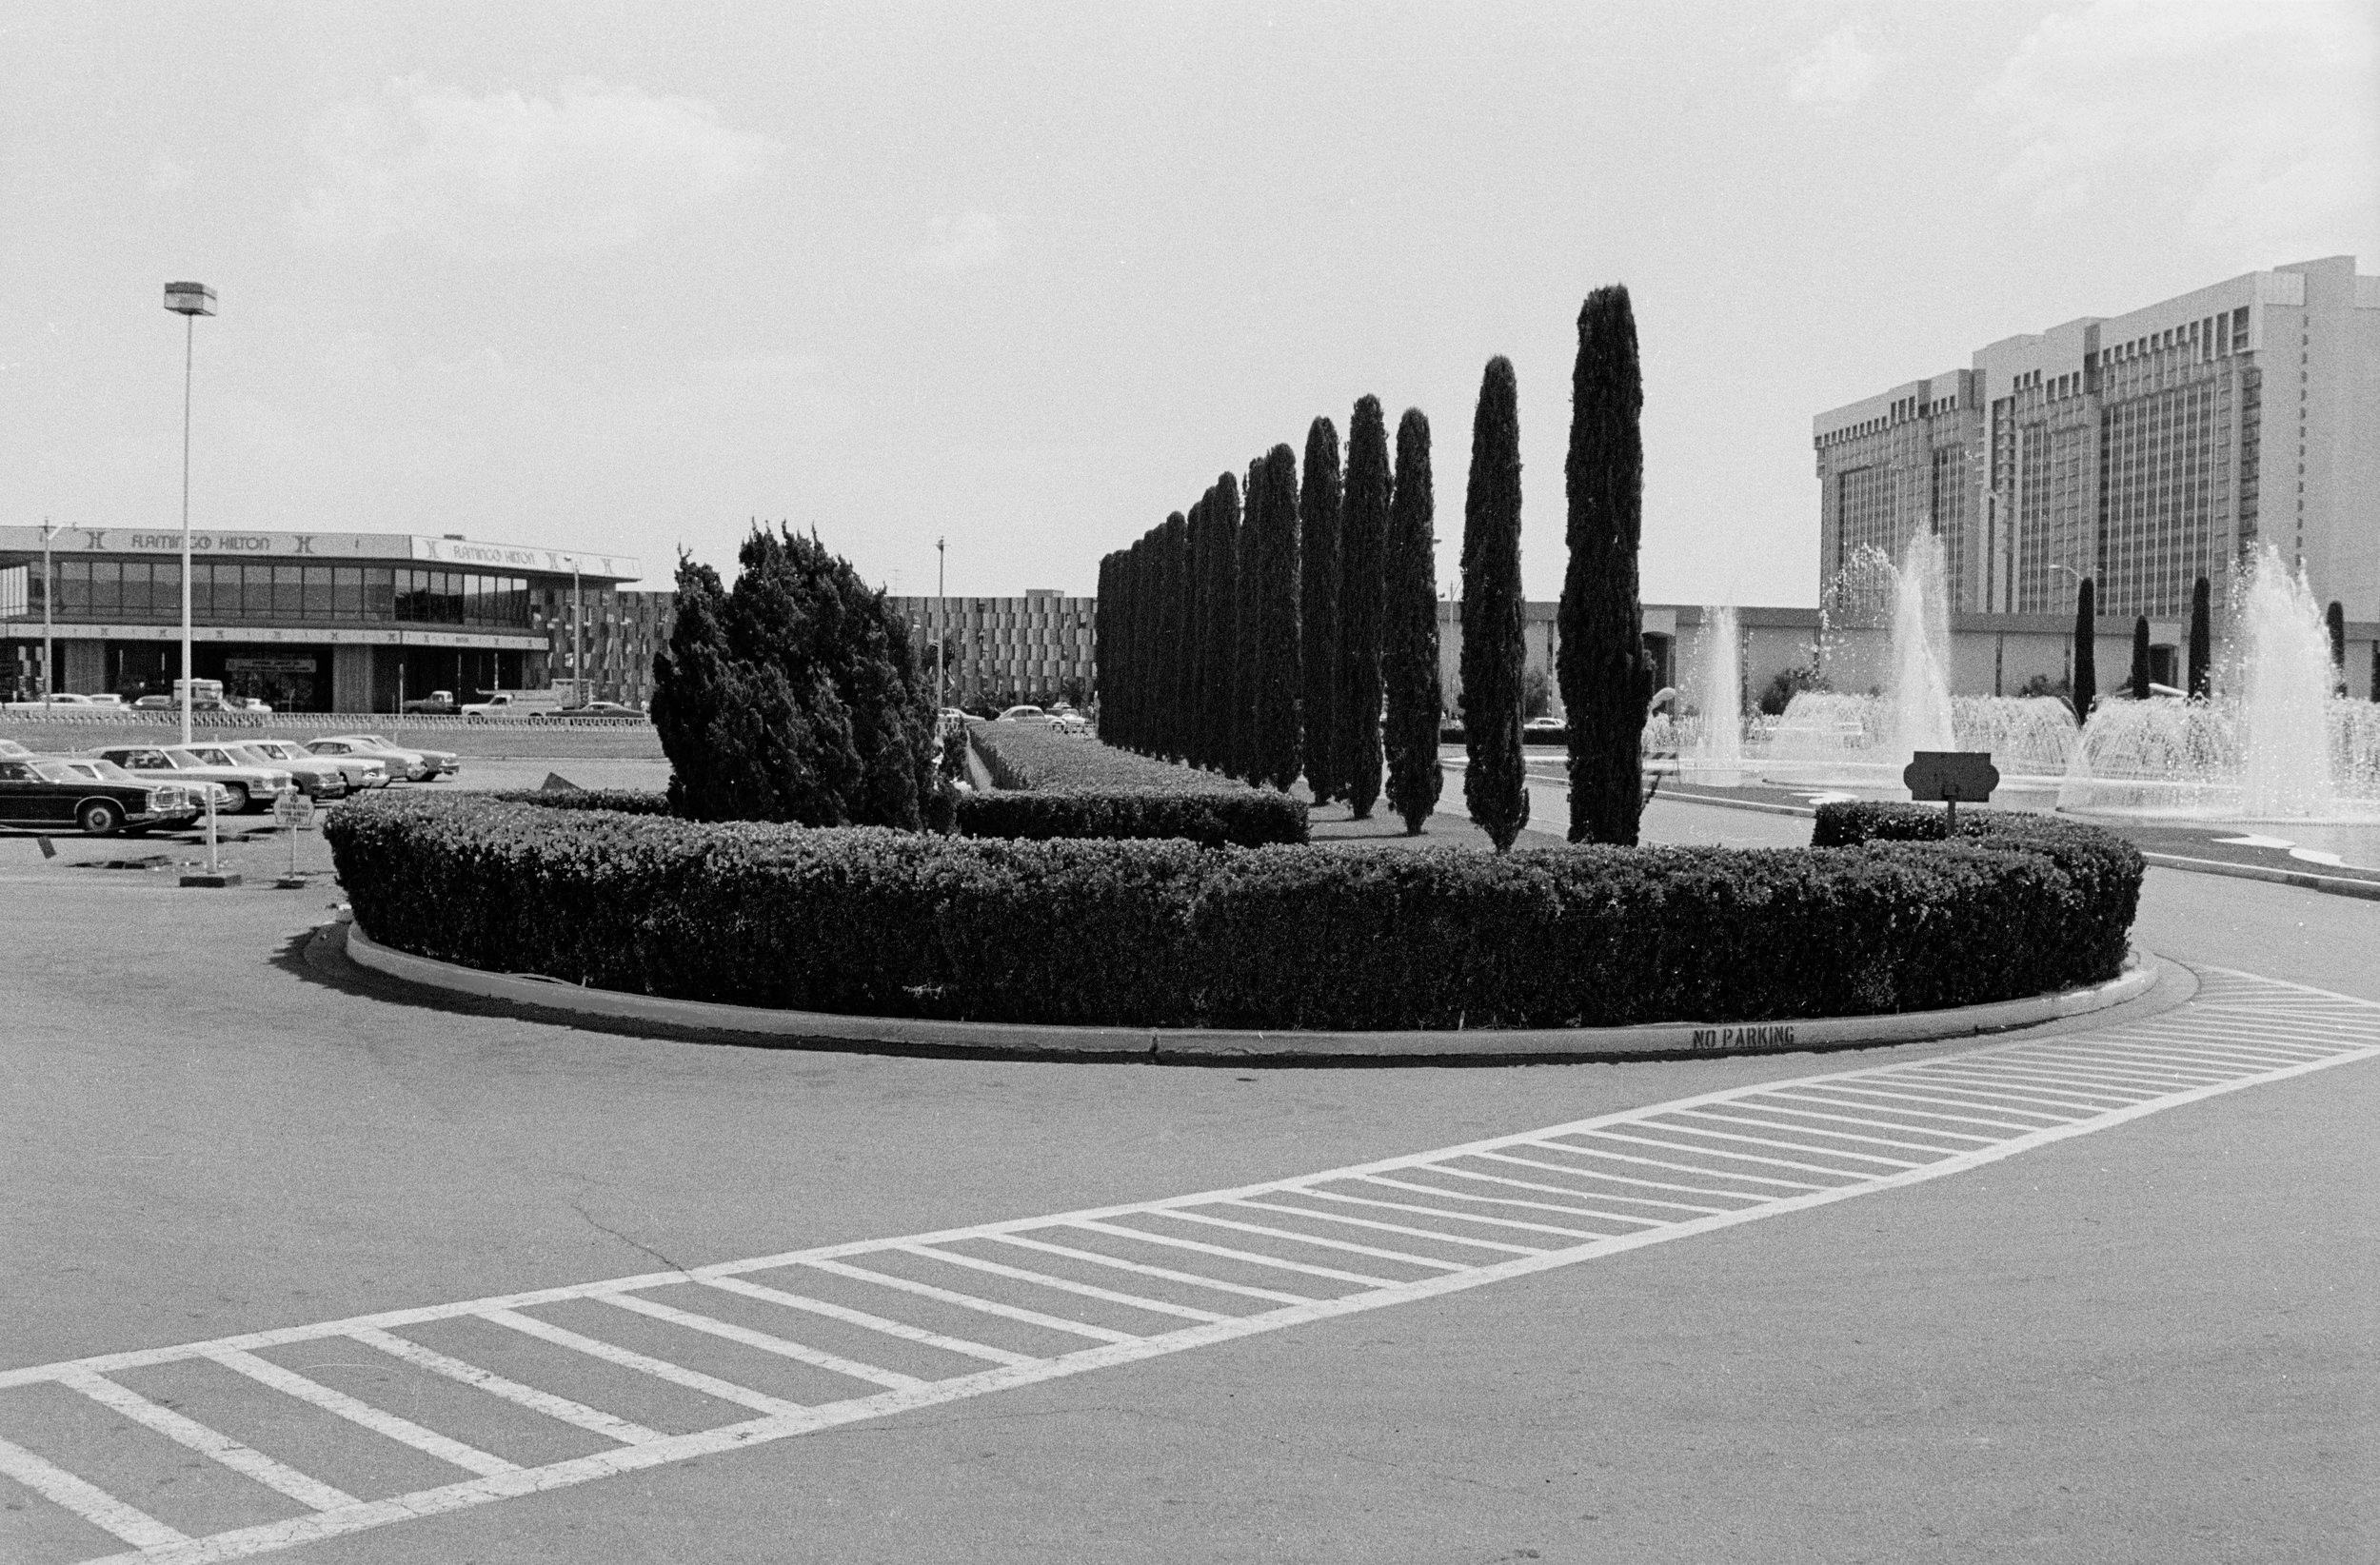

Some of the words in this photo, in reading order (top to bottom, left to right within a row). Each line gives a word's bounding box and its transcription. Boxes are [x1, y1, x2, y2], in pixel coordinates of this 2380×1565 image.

[131, 534, 212, 550] FLAMINGO
[219, 536, 270, 551] HILTON
[453, 545, 501, 562] FLAMINGO
[504, 548, 535, 565] HILTON
[1693, 1029, 1716, 1048] NO
[1721, 1026, 1795, 1047] PARKING
